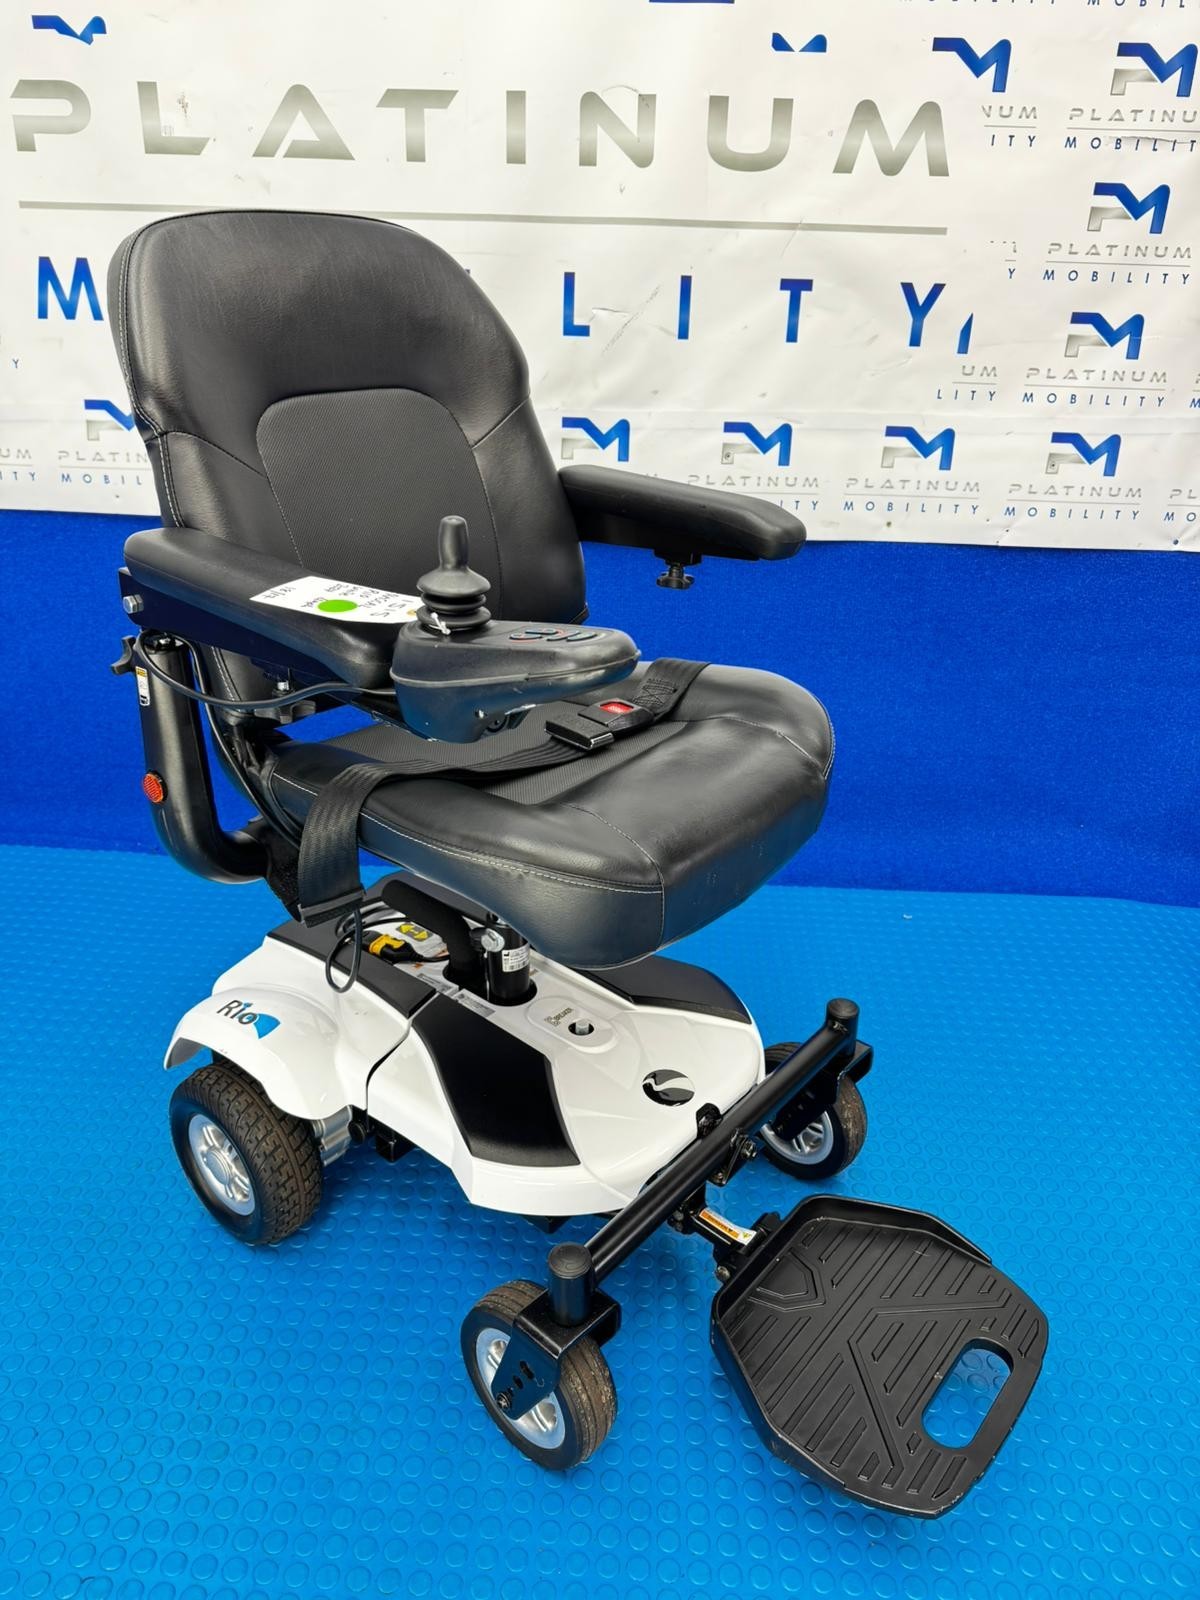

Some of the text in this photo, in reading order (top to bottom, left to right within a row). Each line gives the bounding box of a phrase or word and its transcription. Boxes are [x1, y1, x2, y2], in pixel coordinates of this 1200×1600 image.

[1068, 107, 1198, 123] PLATINU
[10, 79, 949, 177] PLATINUM
[991, 134, 1036, 147] ITY
[1064, 136, 1197, 152] MOBILIT
[1047, 241, 1192, 259] PLATINUM
[1043, 268, 1190, 285] MOBILITY
[1026, 367, 1167, 384] PLATINUM
[936, 388, 996, 402] LITY
[1022, 391, 1164, 408] MOBILITY
[61, 472, 143, 486] MOBIL
[687, 474, 819, 488] PLATINUM
[845, 477, 980, 493] PLATINUM
[1008, 482, 1142, 498] PLATINUM
[843, 500, 979, 515] MOBILITY
[1004, 506, 1139, 521] MOBILITY
[216, 1000, 258, 1025] Rio
